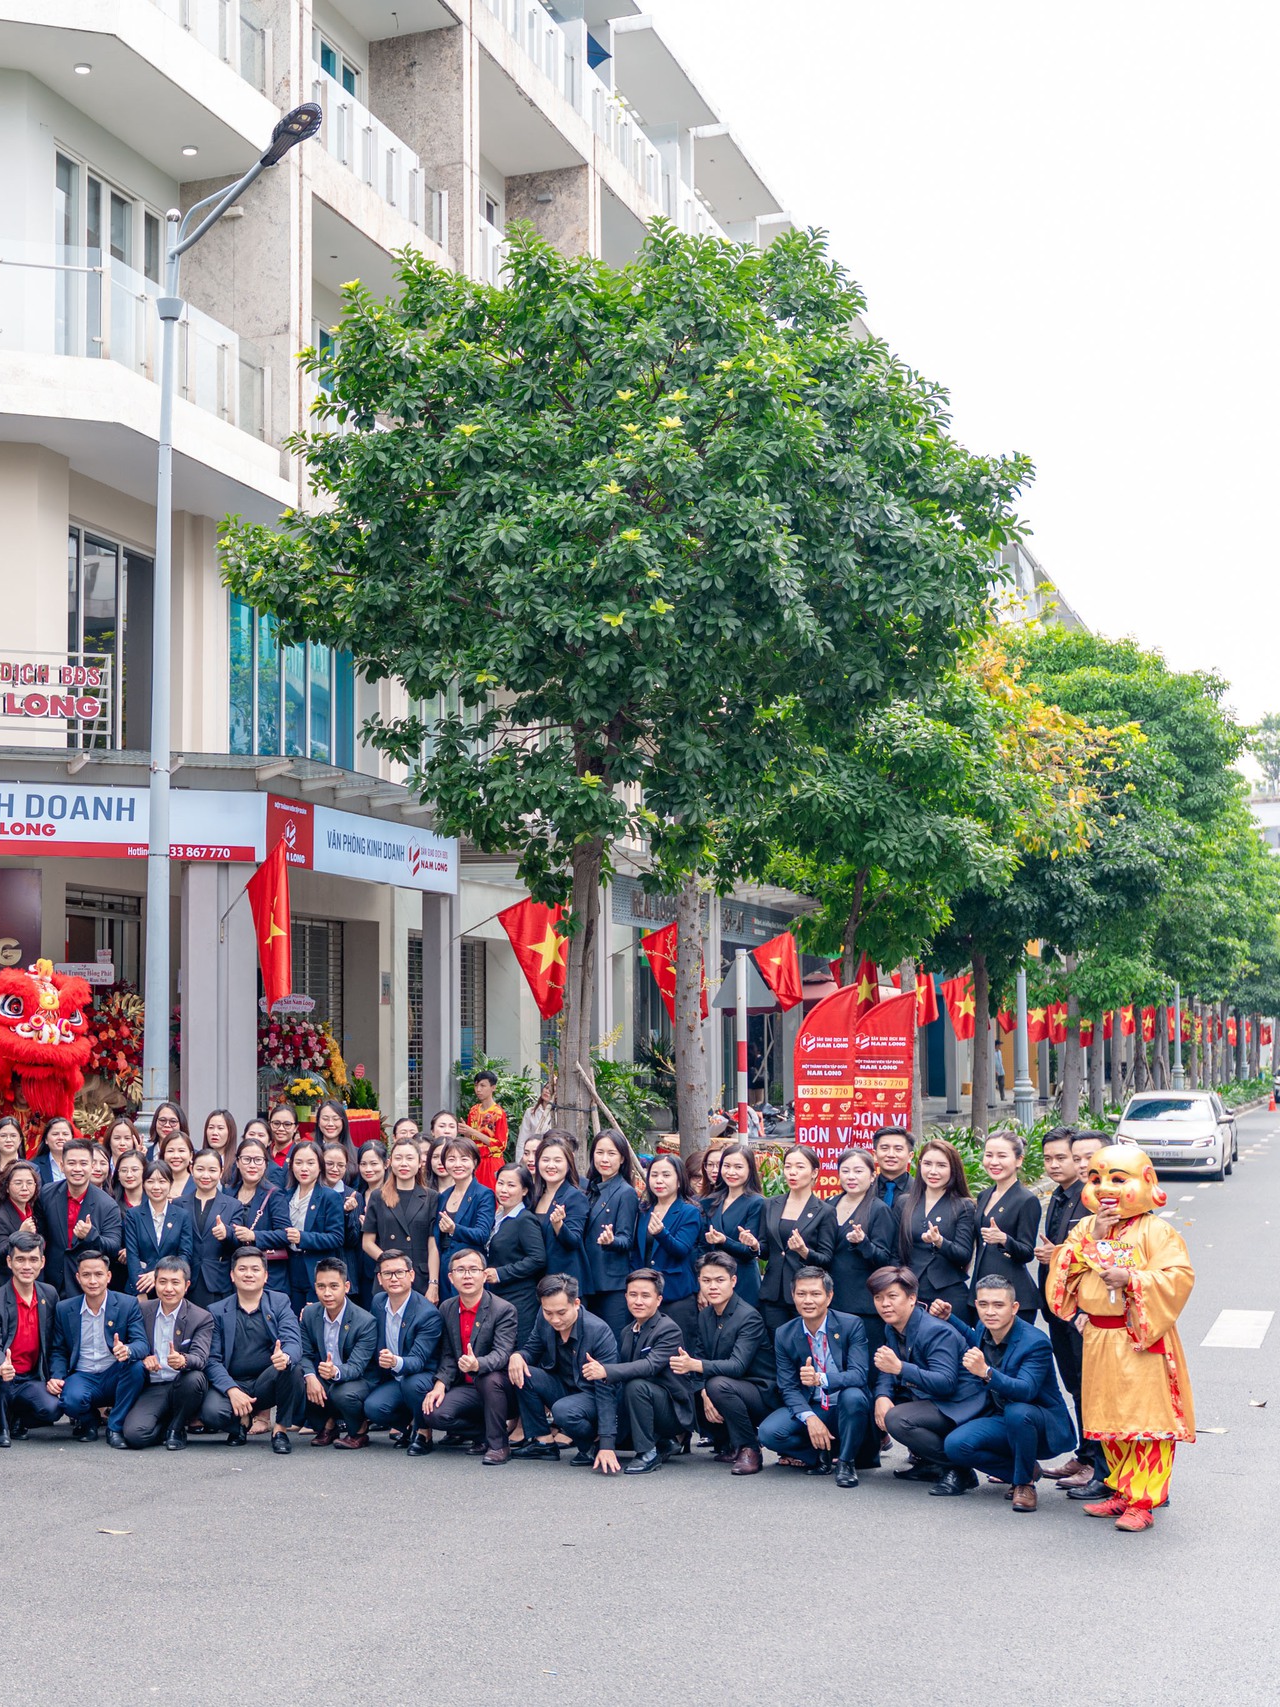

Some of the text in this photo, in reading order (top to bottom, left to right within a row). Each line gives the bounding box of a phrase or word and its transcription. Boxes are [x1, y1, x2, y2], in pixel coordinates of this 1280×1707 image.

[61, 666, 101, 686] BĐS
[4, 692, 100, 718] LONG
[25, 794, 135, 822] DOANH
[0, 822, 56, 837] LONG
[186, 847, 207, 858] 867
[209, 847, 230, 858] 770
[327, 829, 404, 861] VĂN PHÒNG KINH DOANH
[291, 852, 305, 864] LONG
[421, 860, 448, 872] NAM LONG
[891, 1113, 907, 1129] VỊ
[799, 1125, 852, 1145] ĐƠN VỊ
